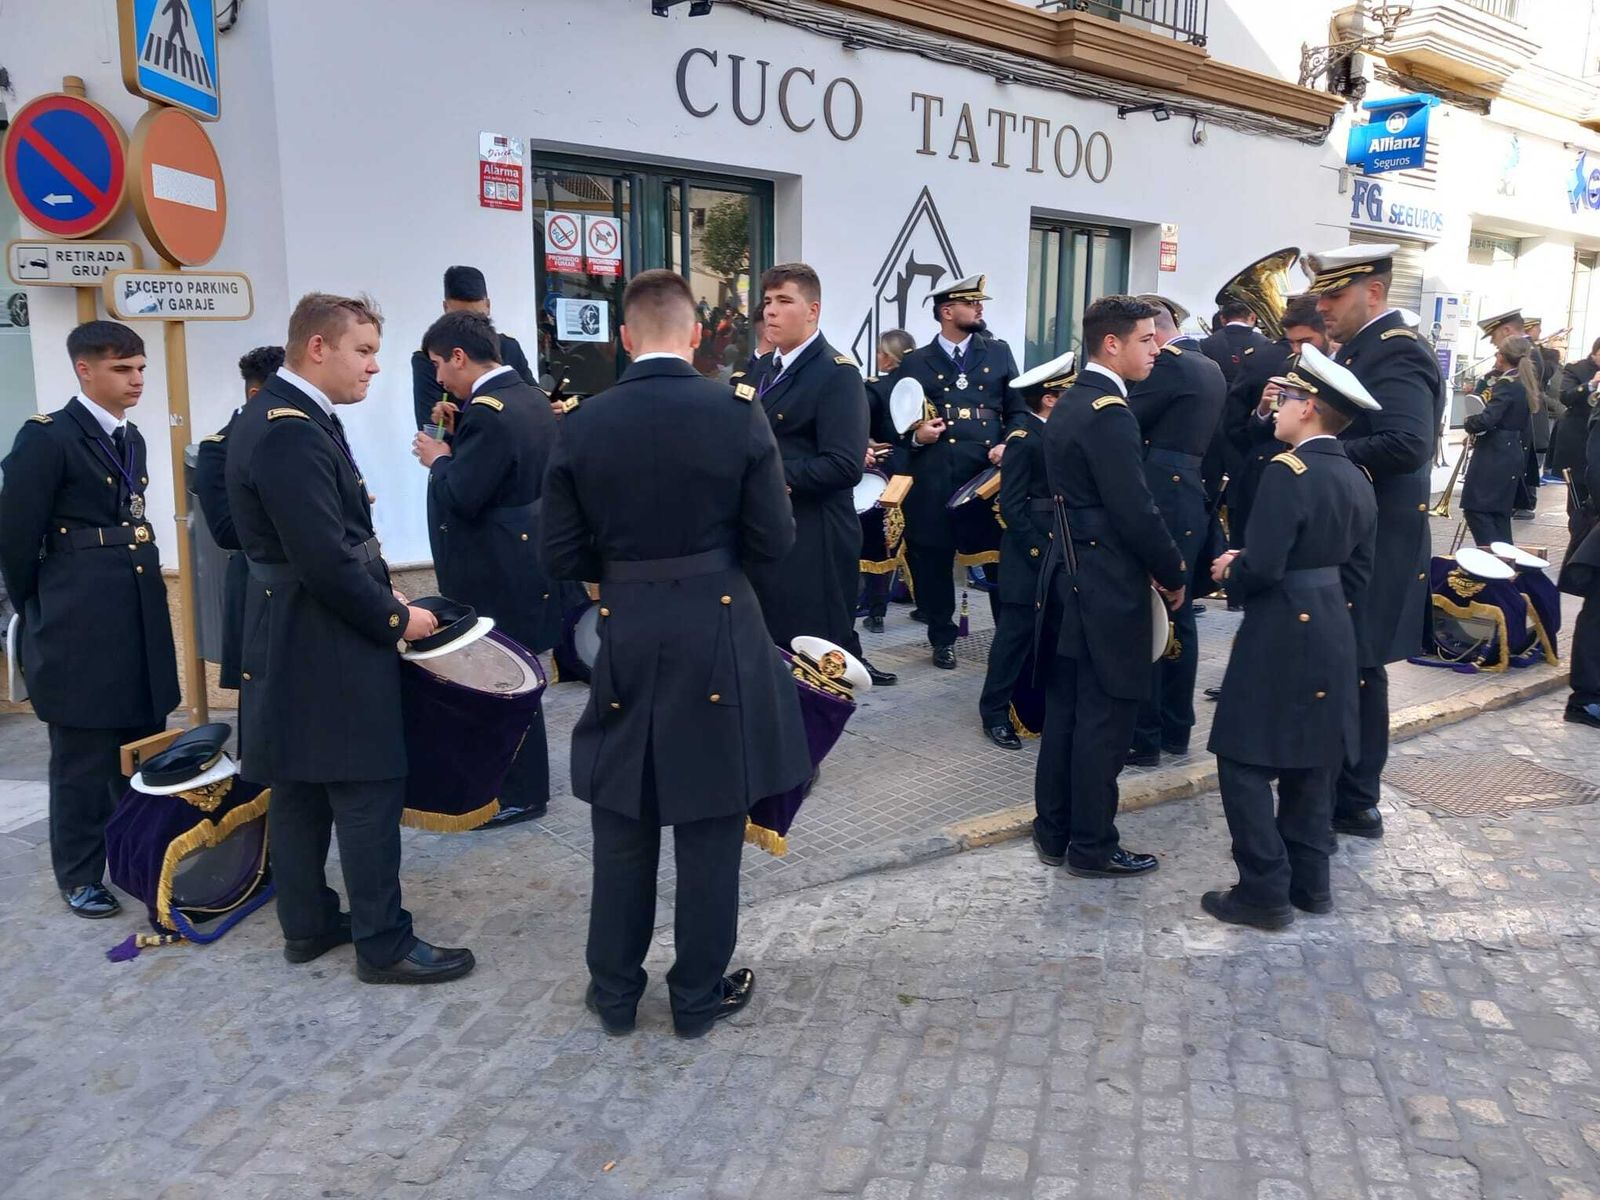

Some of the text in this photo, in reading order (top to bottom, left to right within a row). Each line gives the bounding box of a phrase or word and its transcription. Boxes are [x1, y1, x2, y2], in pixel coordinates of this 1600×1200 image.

[676, 48, 1112, 183] CUCO TATTOO
[1368, 136, 1421, 153] Allianz
[1373, 157, 1410, 169] Seguros
[484, 164, 519, 178] Alarma
[1351, 180, 1444, 232] FG SEGUROS
[55, 251, 125, 262] RETIRADA
[125, 281, 239, 294] EXCEPTO PARKING
[157, 299, 215, 310] Y GARAJE
